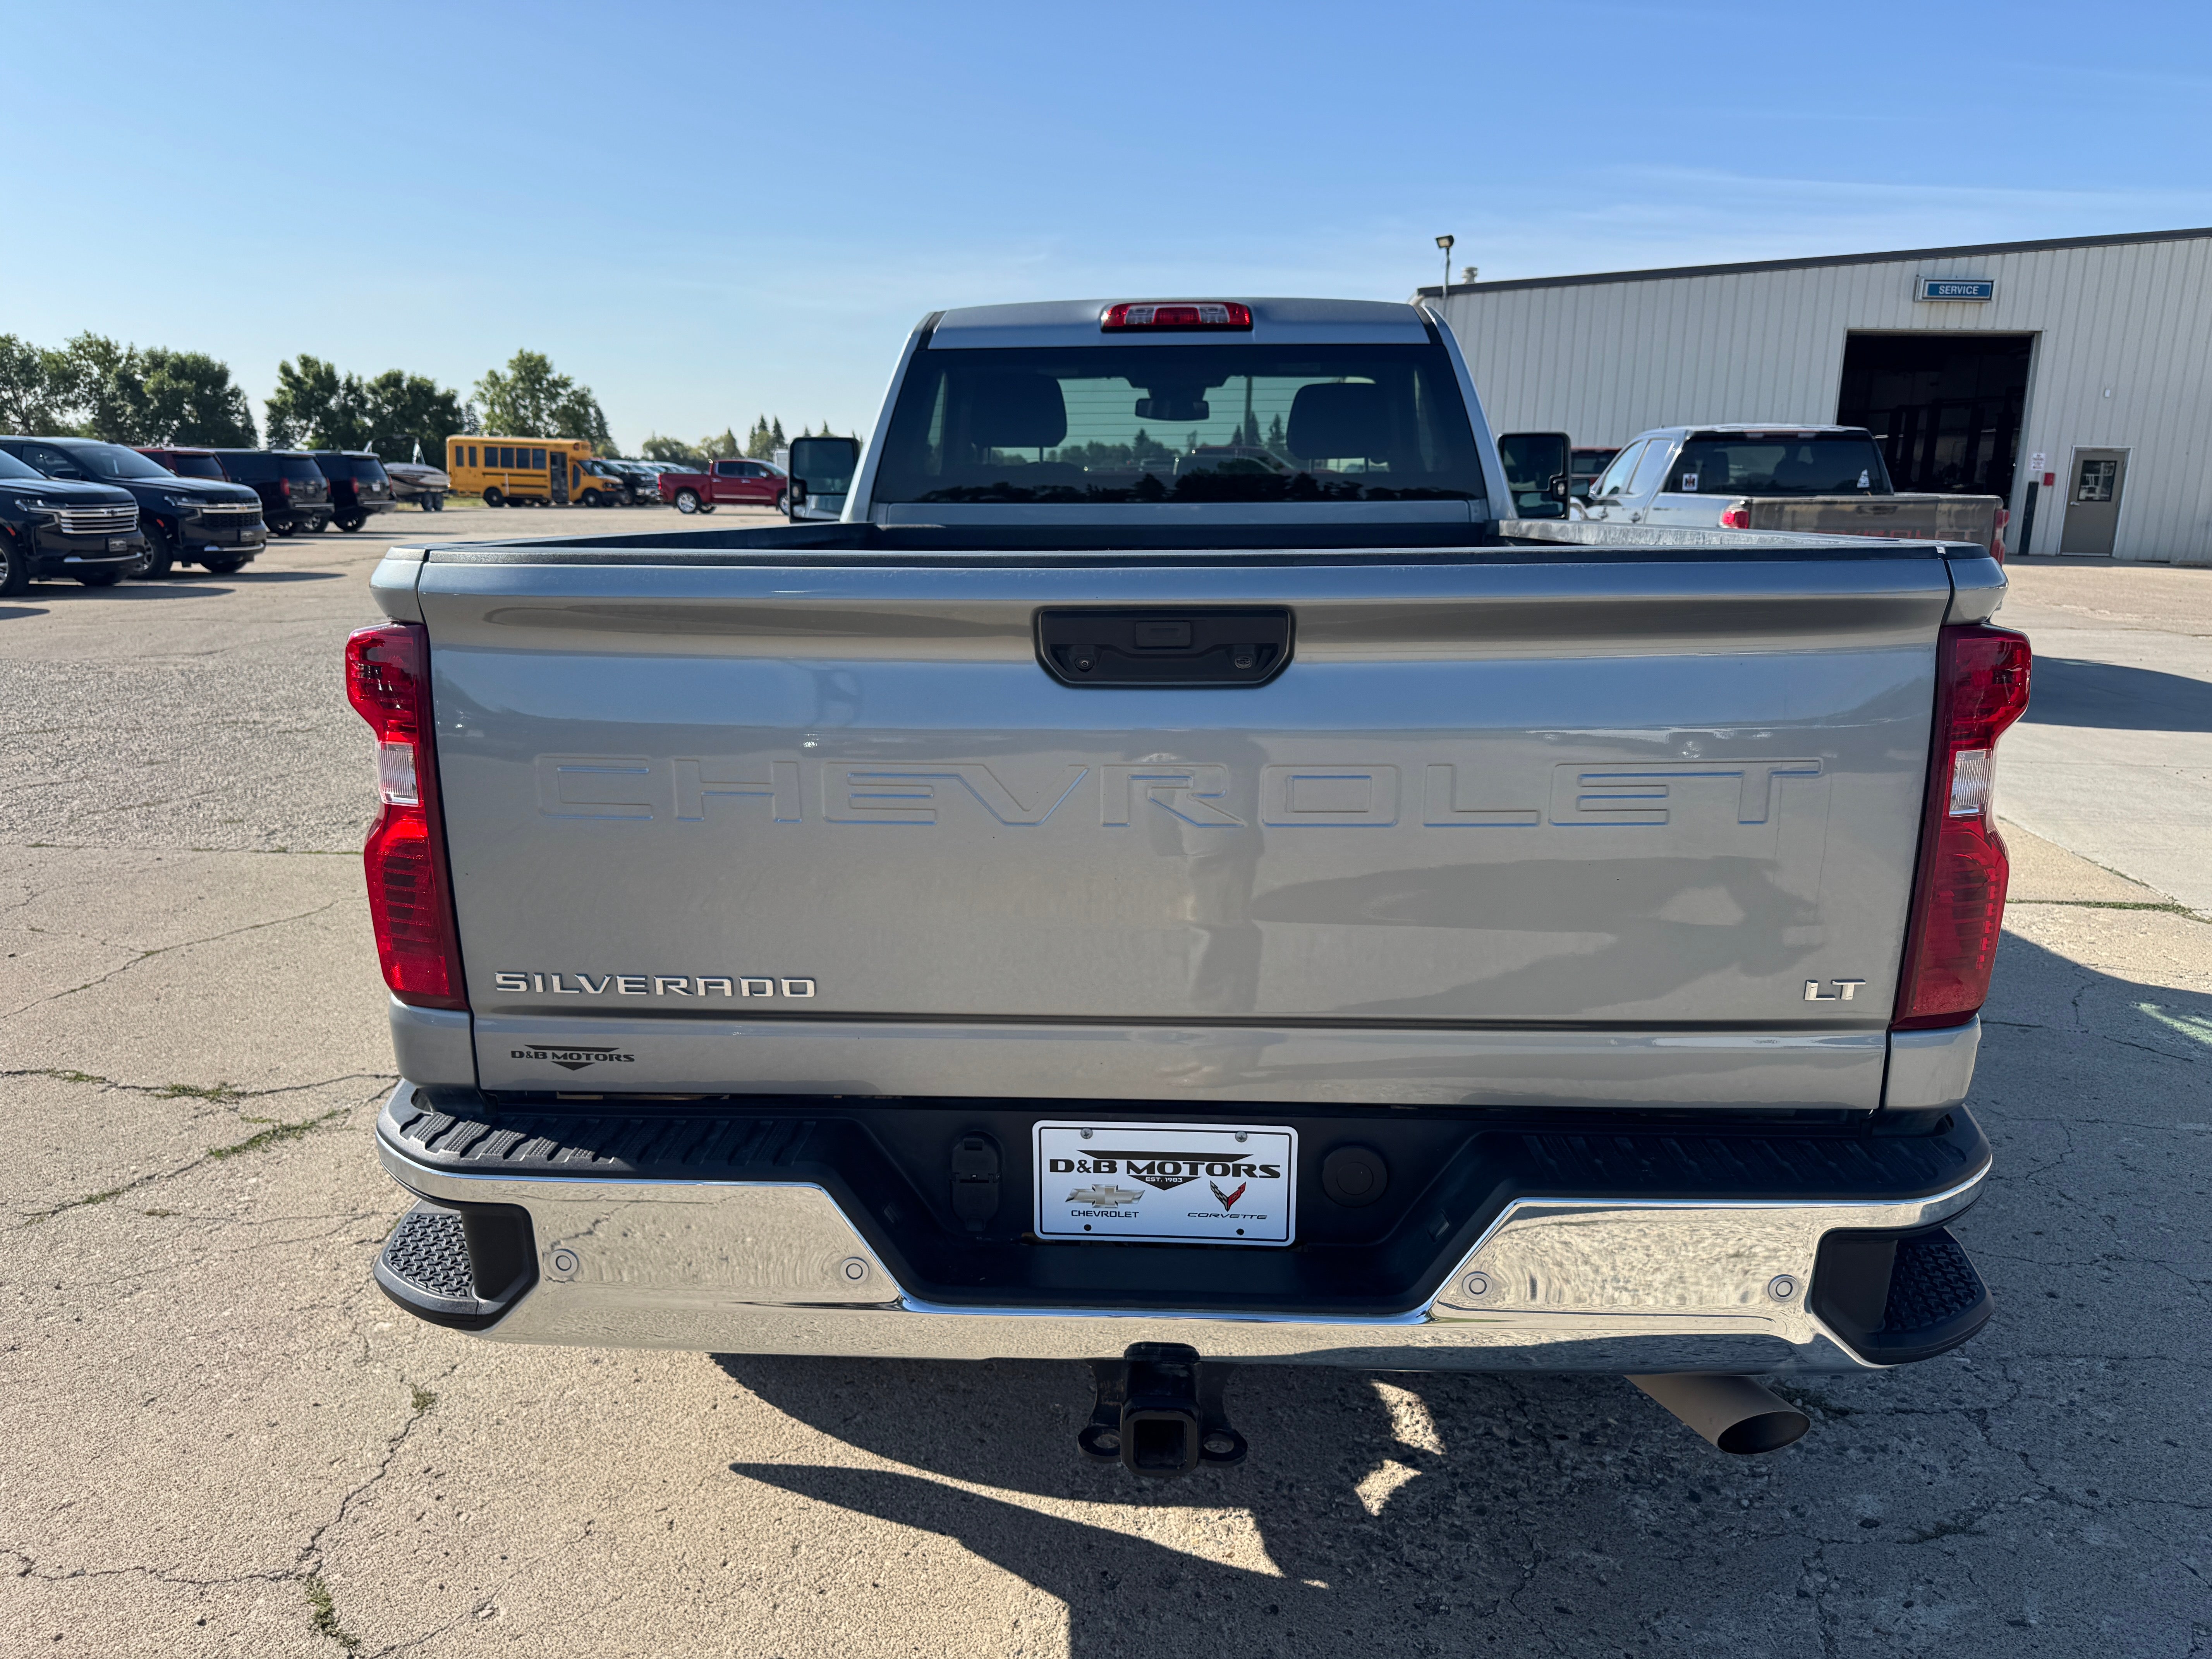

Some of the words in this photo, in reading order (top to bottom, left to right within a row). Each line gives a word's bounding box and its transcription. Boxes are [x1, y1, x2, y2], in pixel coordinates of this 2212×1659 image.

[1939, 285, 1979, 295] SERVICE
[536, 754, 1823, 829] CHEVROLET
[495, 971, 816, 998] SILVERADO
[1804, 979, 1866, 1001] LT
[511, 1050, 548, 1060] D&B
[551, 1052, 635, 1062] MOTORS
[1049, 1158, 1118, 1174] D&B
[1126, 1160, 1281, 1179] MOTORS
[1071, 1210, 1139, 1218] CHEVROLET
